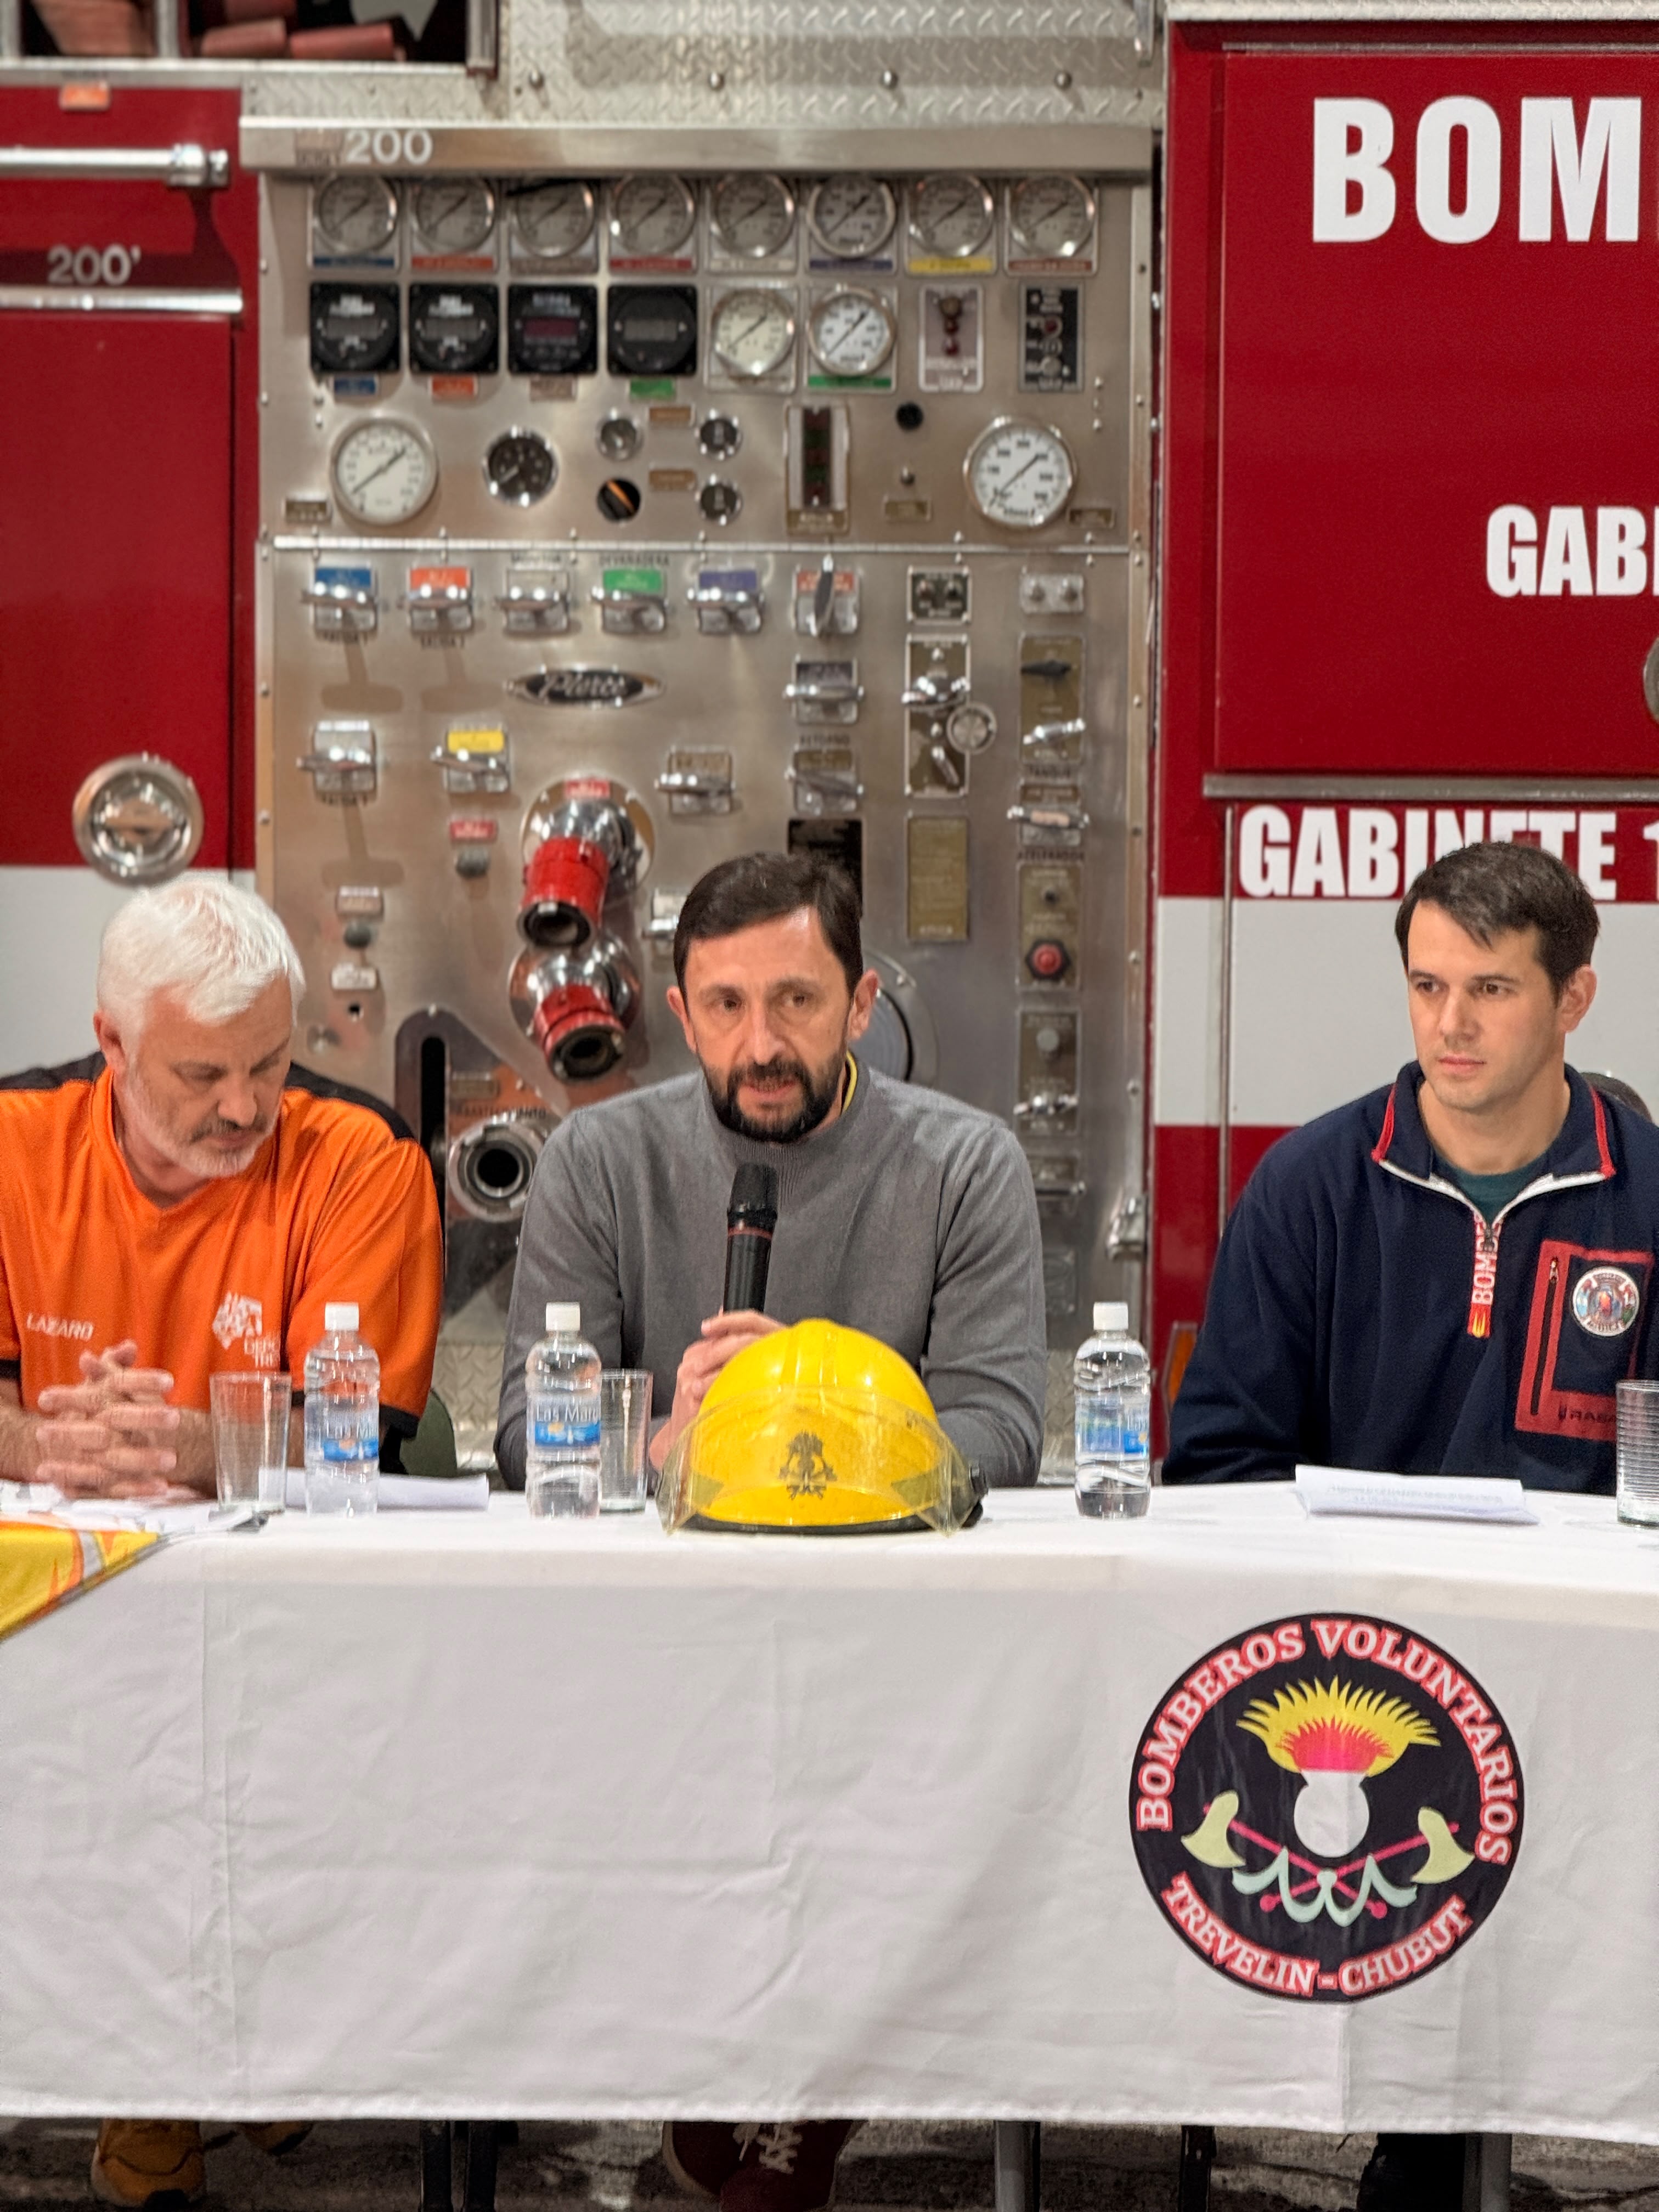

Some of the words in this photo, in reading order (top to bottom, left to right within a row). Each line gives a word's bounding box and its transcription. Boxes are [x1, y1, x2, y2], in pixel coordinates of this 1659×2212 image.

[345, 128, 433, 165] 200
[1313, 95, 1659, 244] BOM
[1486, 504, 1659, 597] GAB
[1137, 1622, 1305, 1831] BOMBEROS
[1311, 1620, 1517, 1865] VOLUNTARIOS
